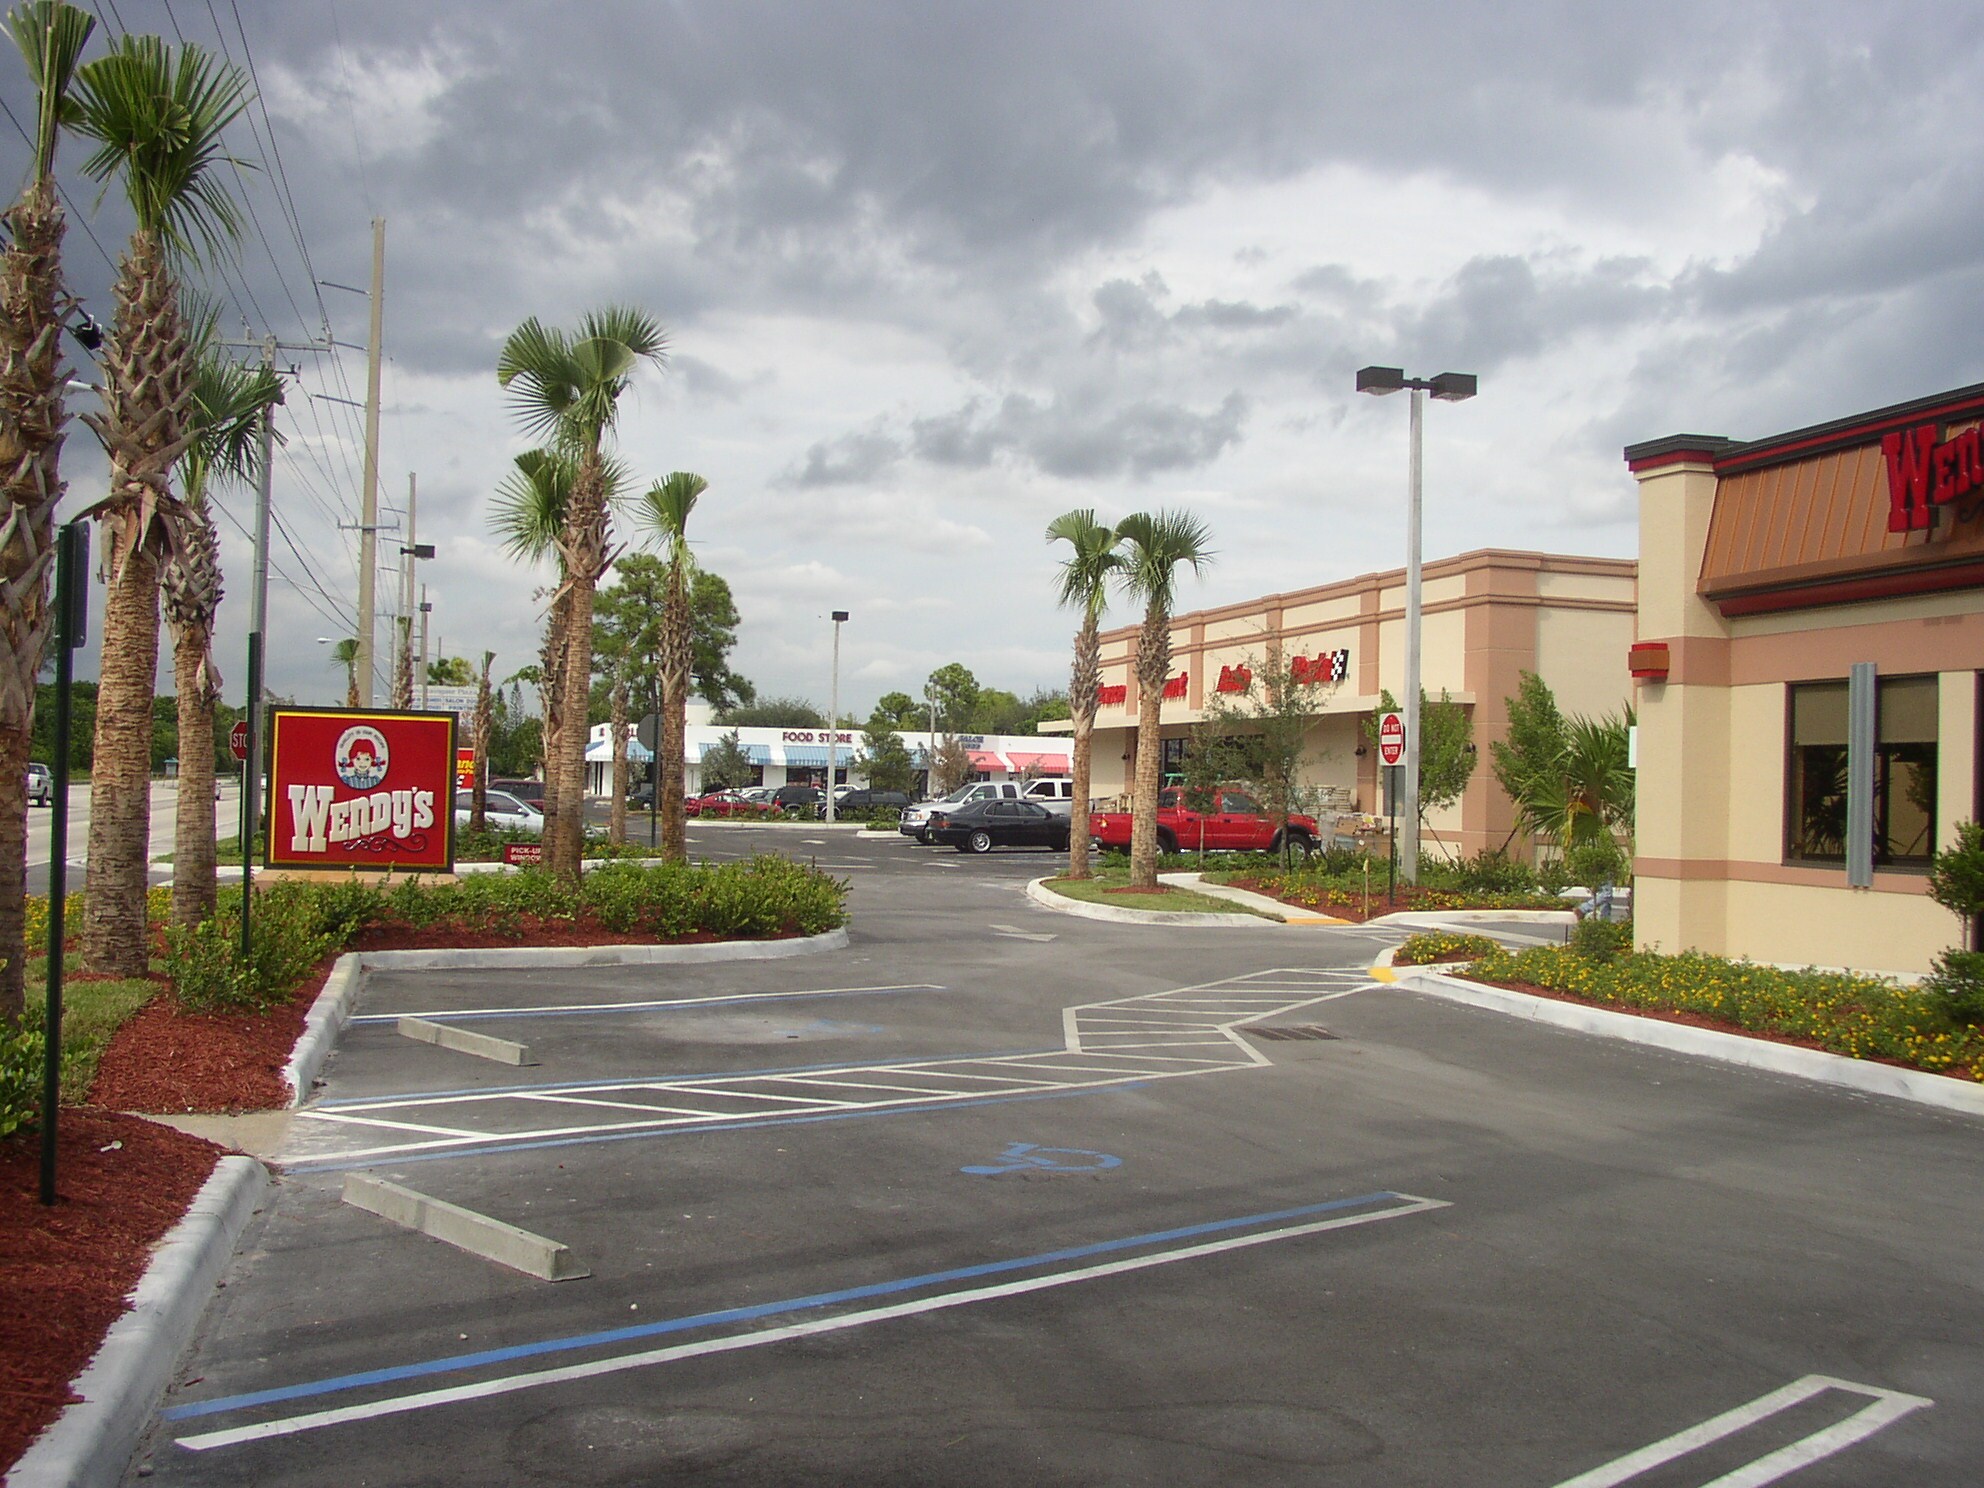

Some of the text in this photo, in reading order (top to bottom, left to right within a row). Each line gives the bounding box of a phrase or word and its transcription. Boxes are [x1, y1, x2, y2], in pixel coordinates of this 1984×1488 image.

[1383, 723, 1400, 733] DO NOT
[232, 732, 248, 748] STO
[782, 731, 814, 743] FOOD
[1384, 746, 1399, 756] ENTER
